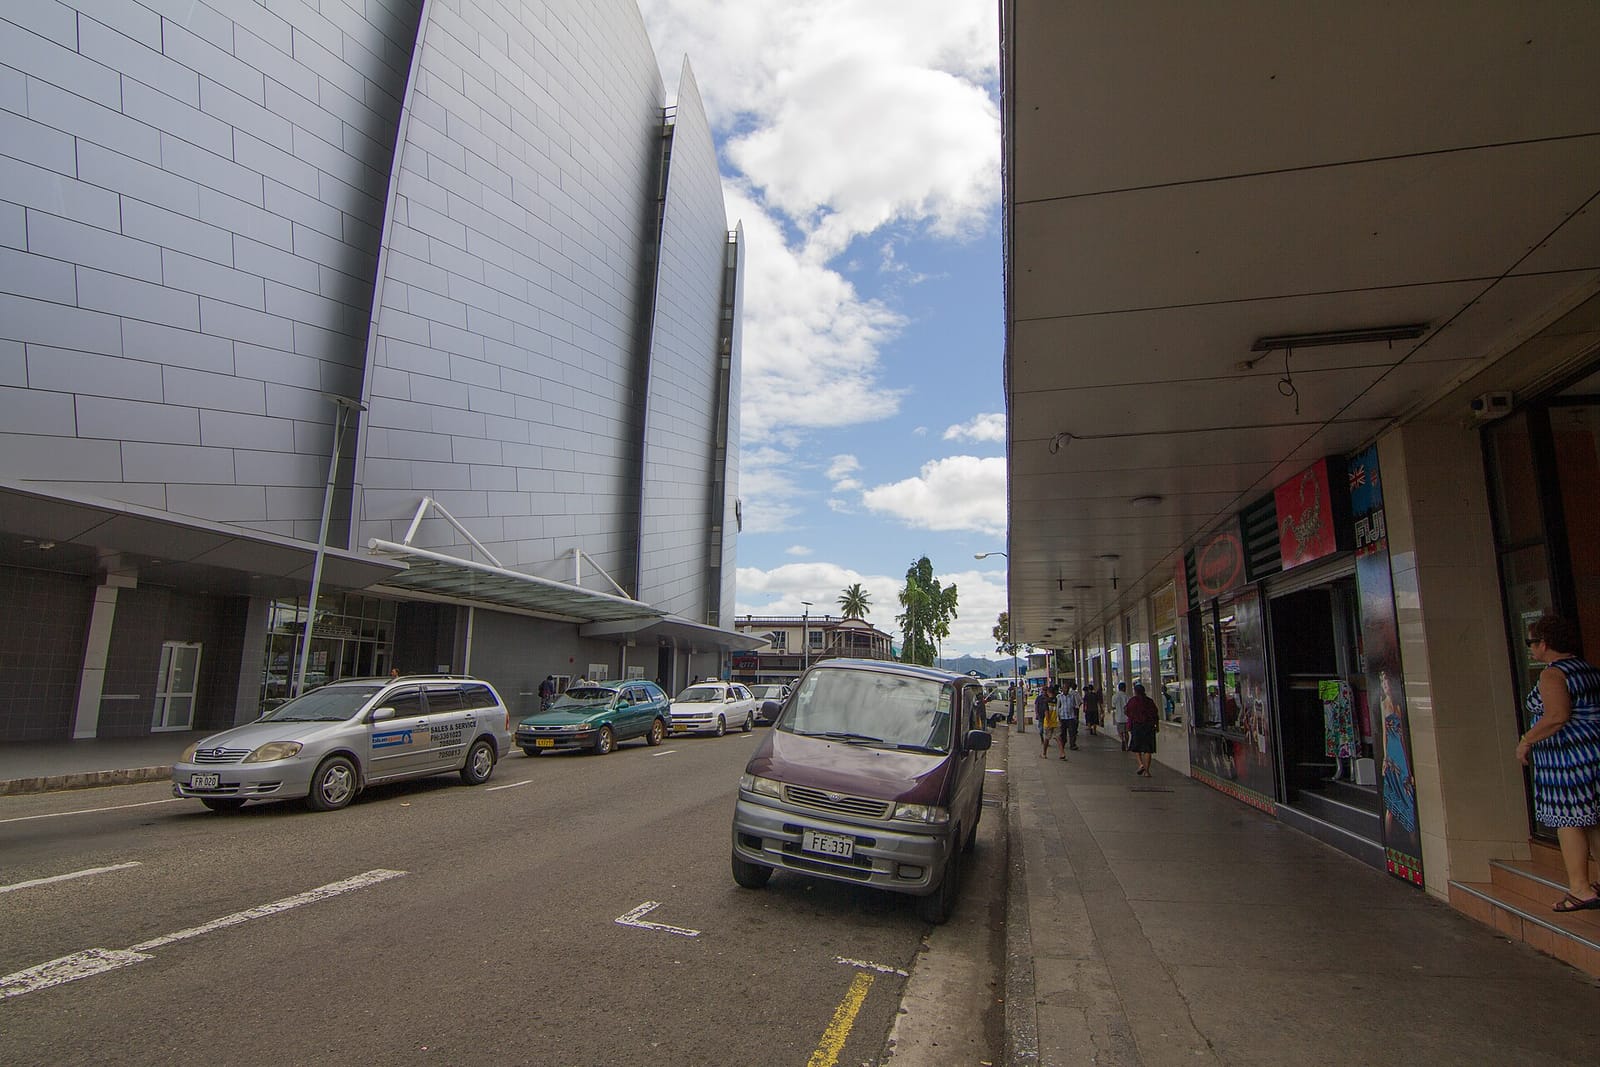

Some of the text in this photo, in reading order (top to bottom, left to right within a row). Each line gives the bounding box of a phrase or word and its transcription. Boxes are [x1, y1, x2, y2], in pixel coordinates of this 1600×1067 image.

[1355, 509, 1386, 548] FIJI
[430, 725, 449, 734] SALES
[455, 720, 477, 730] SERVICE
